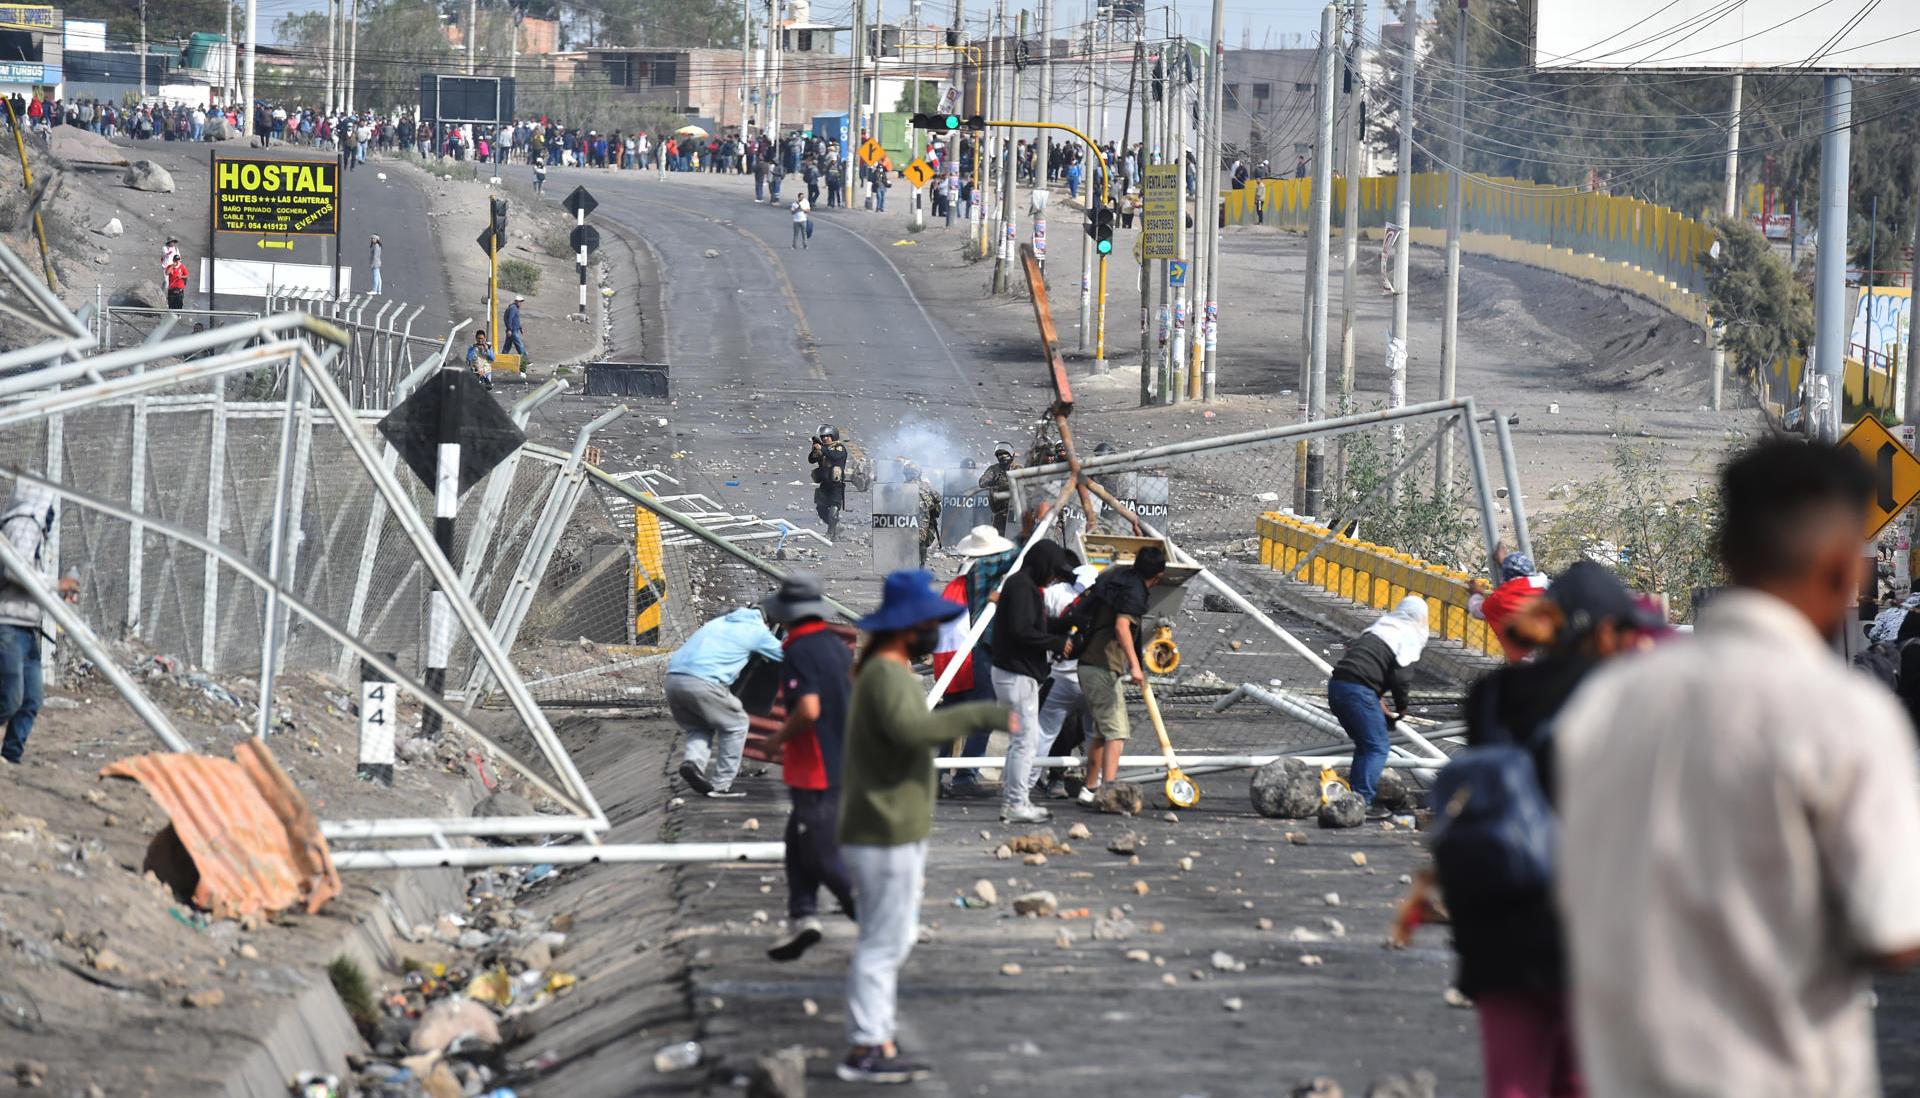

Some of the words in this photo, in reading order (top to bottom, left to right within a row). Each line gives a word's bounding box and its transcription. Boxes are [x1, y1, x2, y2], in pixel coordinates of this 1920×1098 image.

[12, 66, 43, 77] TURBOS
[220, 163, 333, 193] HOSTAL
[1146, 174, 1161, 189] VENTA
[1162, 174, 1177, 189] LOTES
[222, 194, 257, 202] SUITES
[293, 196, 330, 205] CANTERAS
[223, 205, 241, 213] BAÑO
[294, 203, 334, 231] EVENTOS
[1137, 506, 1168, 517] OLICIA
[873, 514, 919, 528] POLICIA
